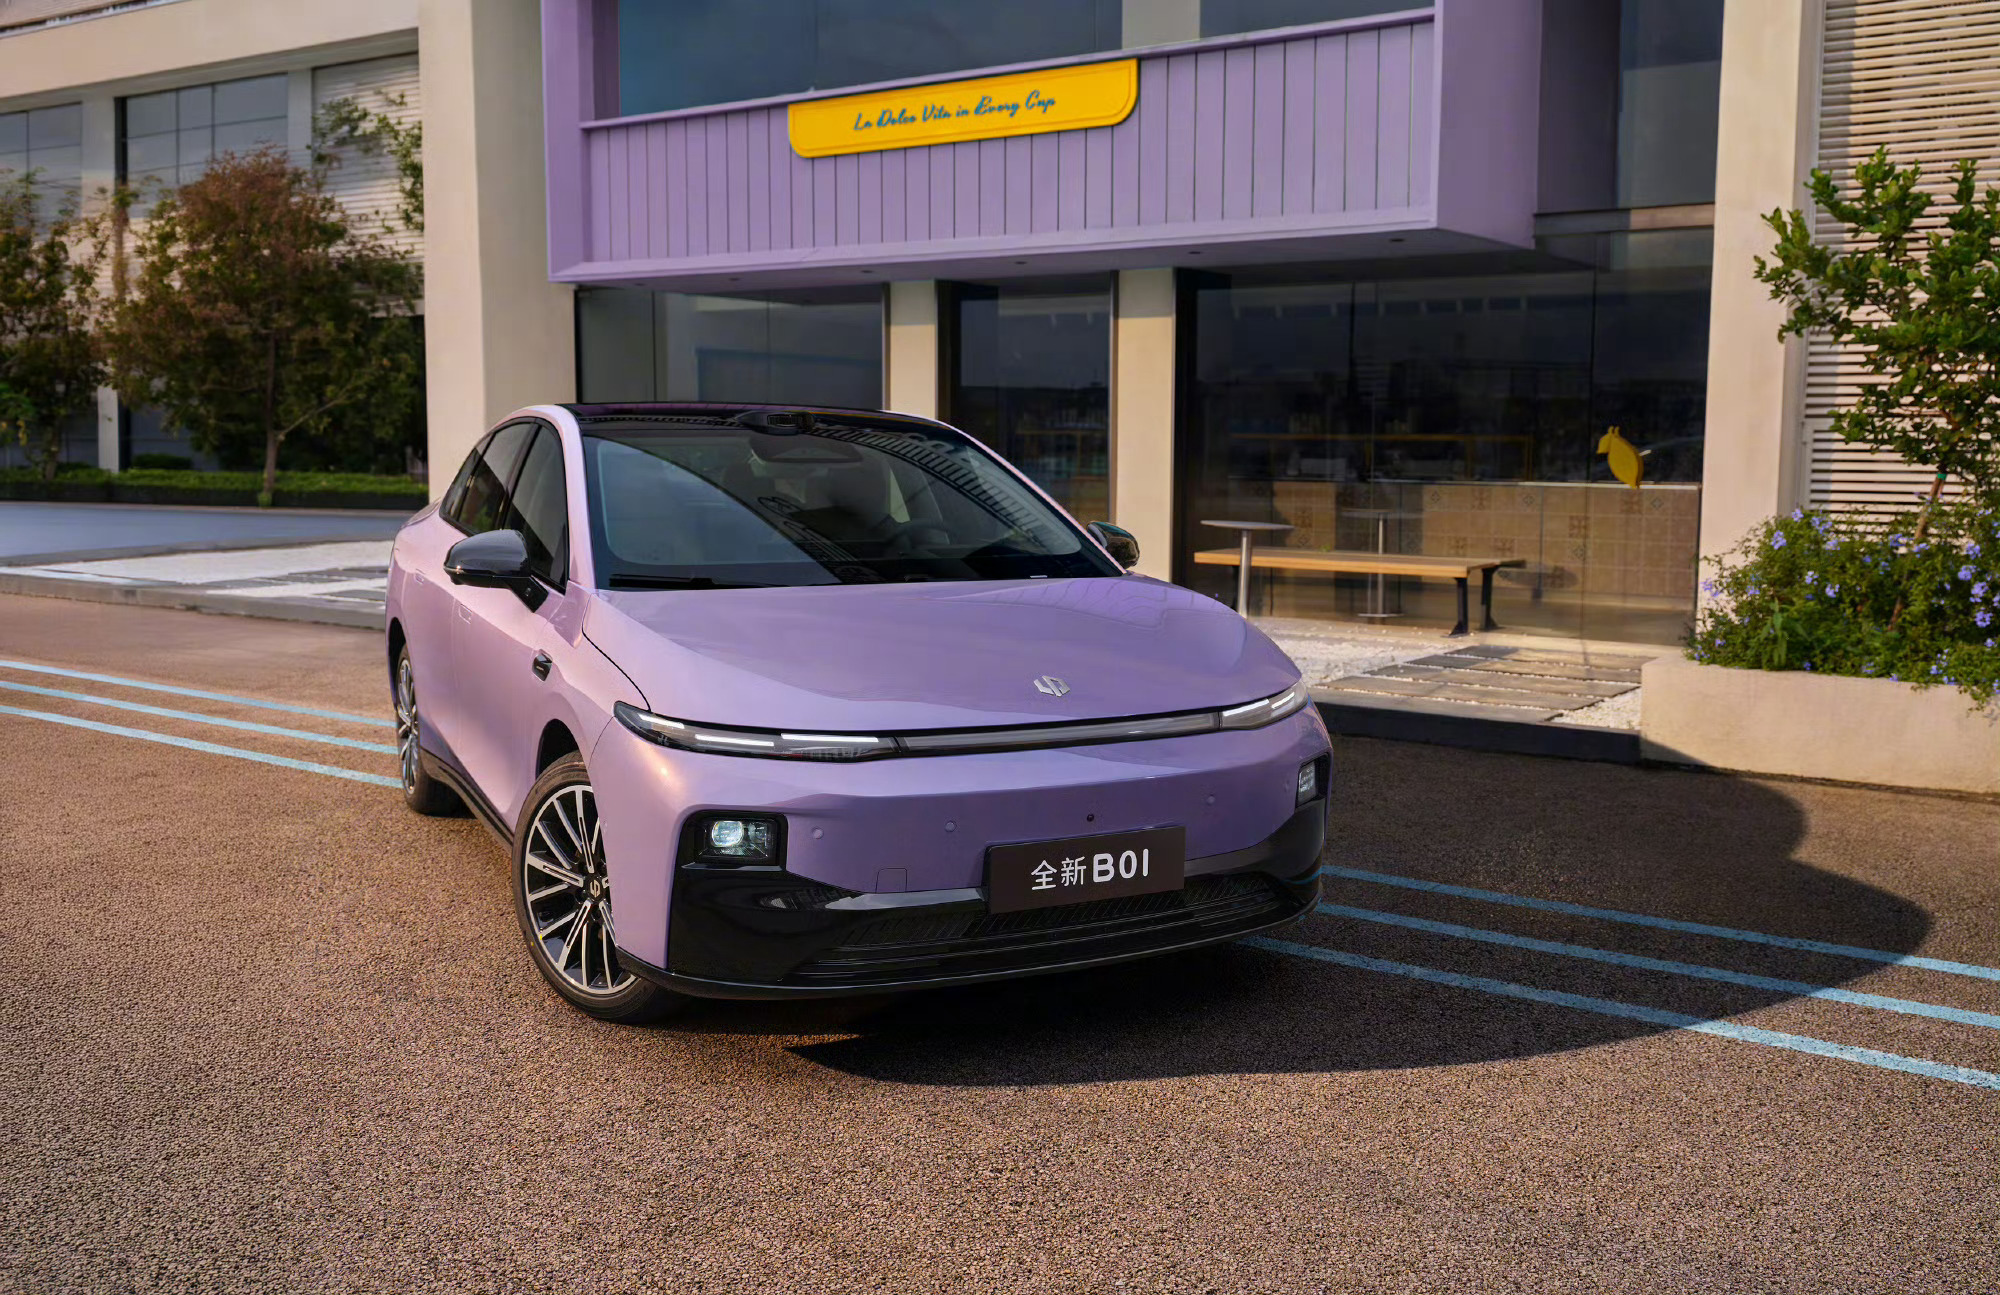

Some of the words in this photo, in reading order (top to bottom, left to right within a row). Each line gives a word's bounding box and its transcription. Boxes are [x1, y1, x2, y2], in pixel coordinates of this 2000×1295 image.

[853, 111, 873, 131] La
[876, 107, 917, 128] Dolce
[921, 103, 952, 123] Vita
[955, 105, 970, 118] in
[973, 95, 1020, 119] Every
[1024, 89, 1055, 114] Cup
[1030, 856, 1087, 891] 全新
